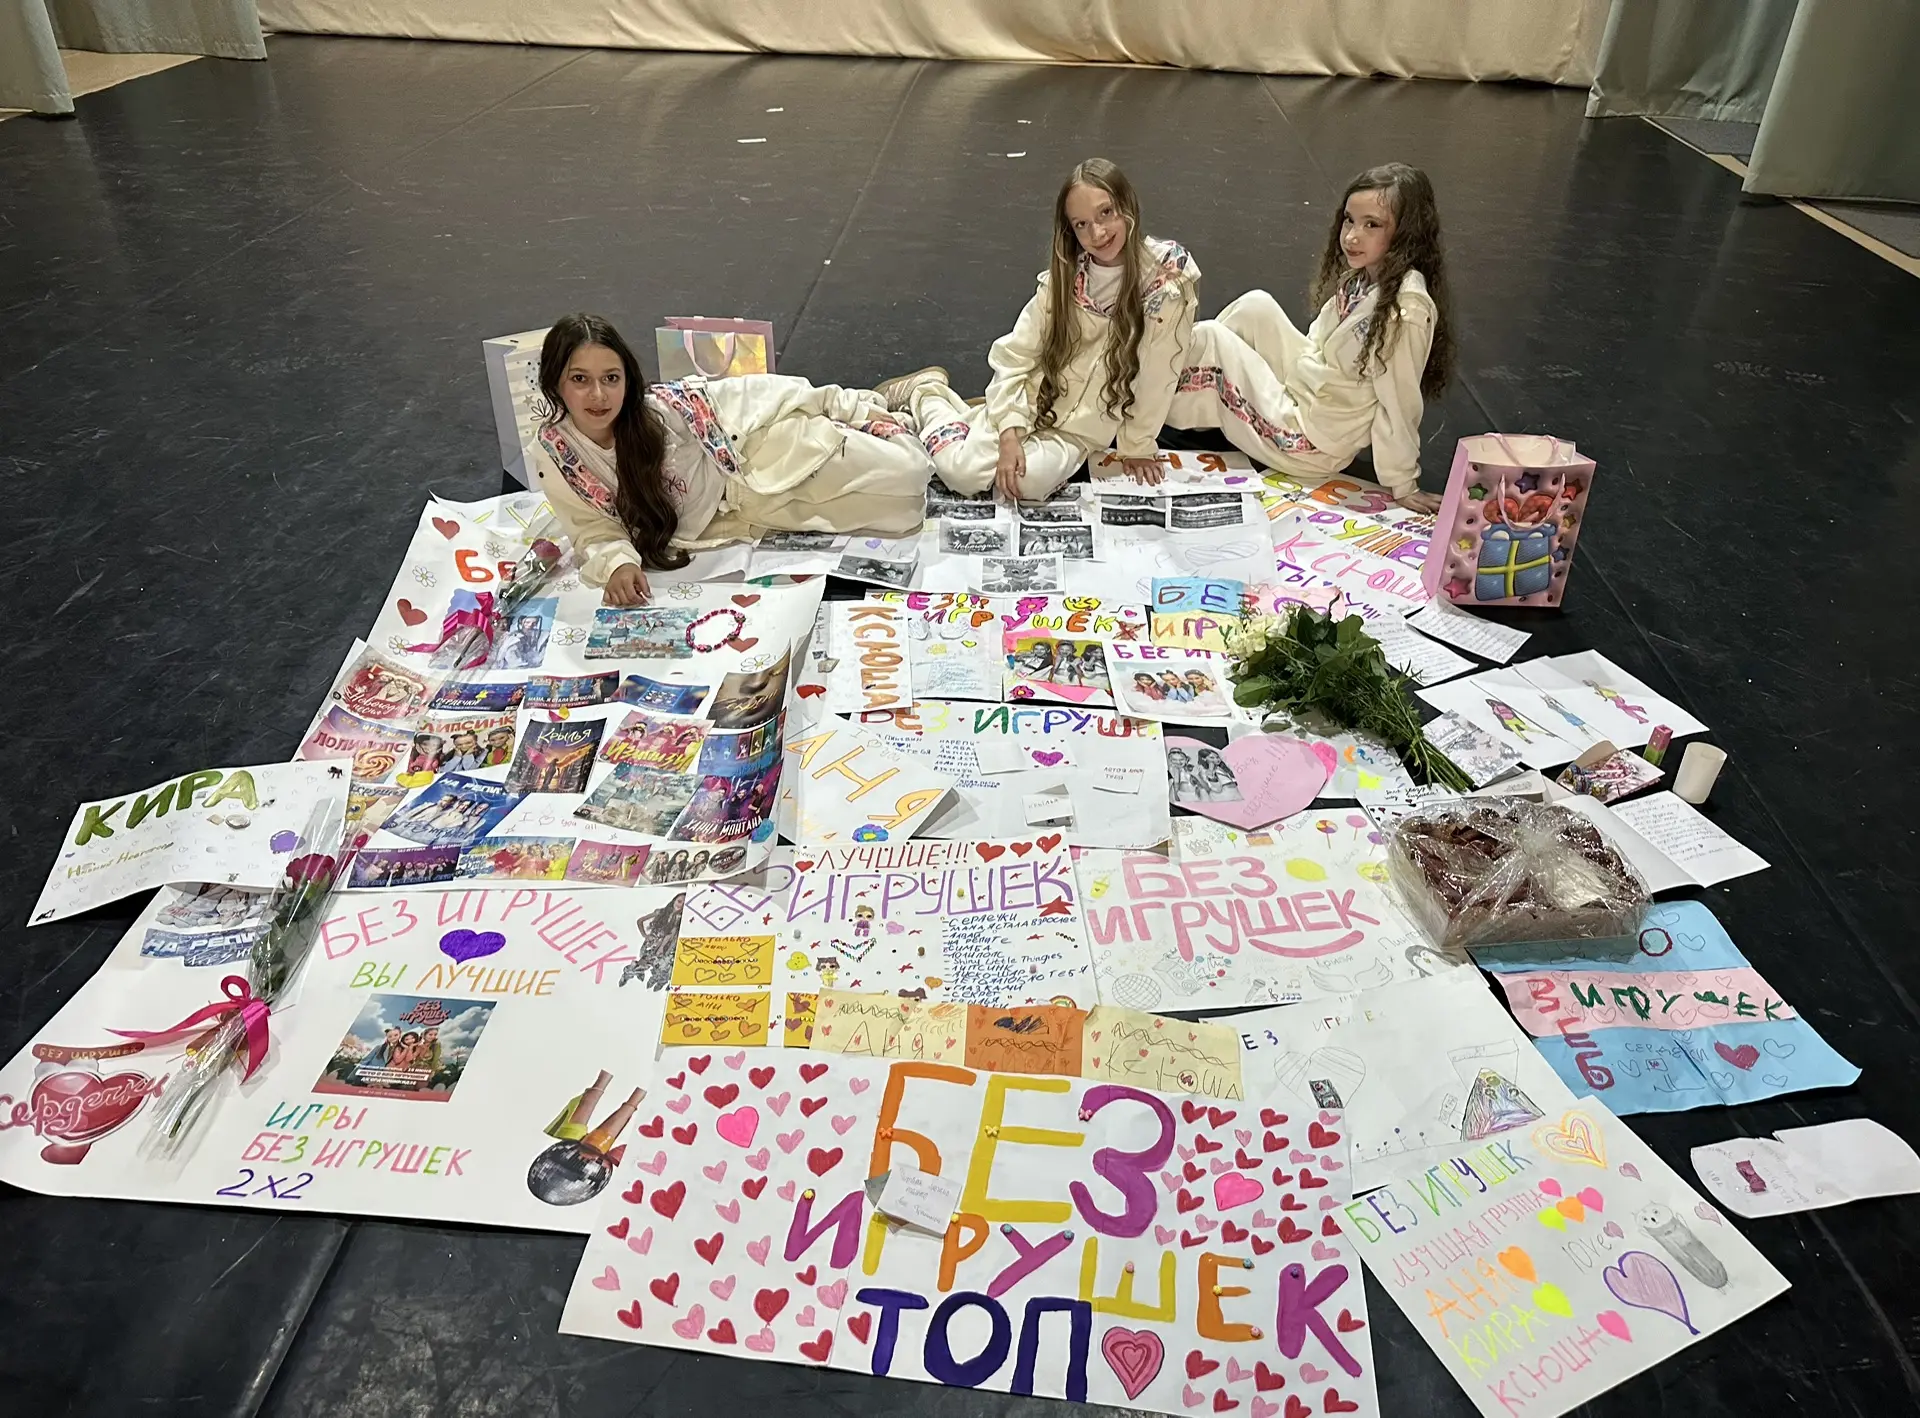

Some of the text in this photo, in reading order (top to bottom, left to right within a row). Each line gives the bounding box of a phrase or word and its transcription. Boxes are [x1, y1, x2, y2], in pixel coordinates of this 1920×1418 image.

[1274, 531, 1431, 604] КСЮШ
[848, 605, 904, 710] КСЮША
[419, 710, 514, 732] ЛИПСИНК
[75, 769, 260, 847] КИРА
[785, 729, 945, 830] АНЯ
[681, 817, 765, 836] ХАННА МОНТАНА
[786, 855, 1075, 923] ИГРУШЕК
[1122, 855, 1279, 900] БЕЗ
[320, 889, 637, 985] БЕЗ ИГРУШЕК
[1086, 888, 1382, 962] ИГРУШЕК
[350, 961, 561, 996] ВЫ ЛУЧШИЕ
[412, 999, 442, 1012] БЕЗ
[841, 1019, 927, 1061] АНЯ
[265, 1101, 369, 1131] ИГРЫ
[868, 1061, 1178, 1238] БЕЗ
[241, 1132, 472, 1176] БЕЗ ИГРУШЕК
[1344, 1139, 1533, 1244] БЕЗ ИГРУШЕК
[1392, 1219, 1492, 1288] ЛУЧШАЯ
[1425, 1256, 1520, 1339] АНЯ
[855, 1286, 1095, 1404] ТОП
[1446, 1303, 1551, 1380] КИРА
[1486, 1324, 1612, 1418] КСЮША
